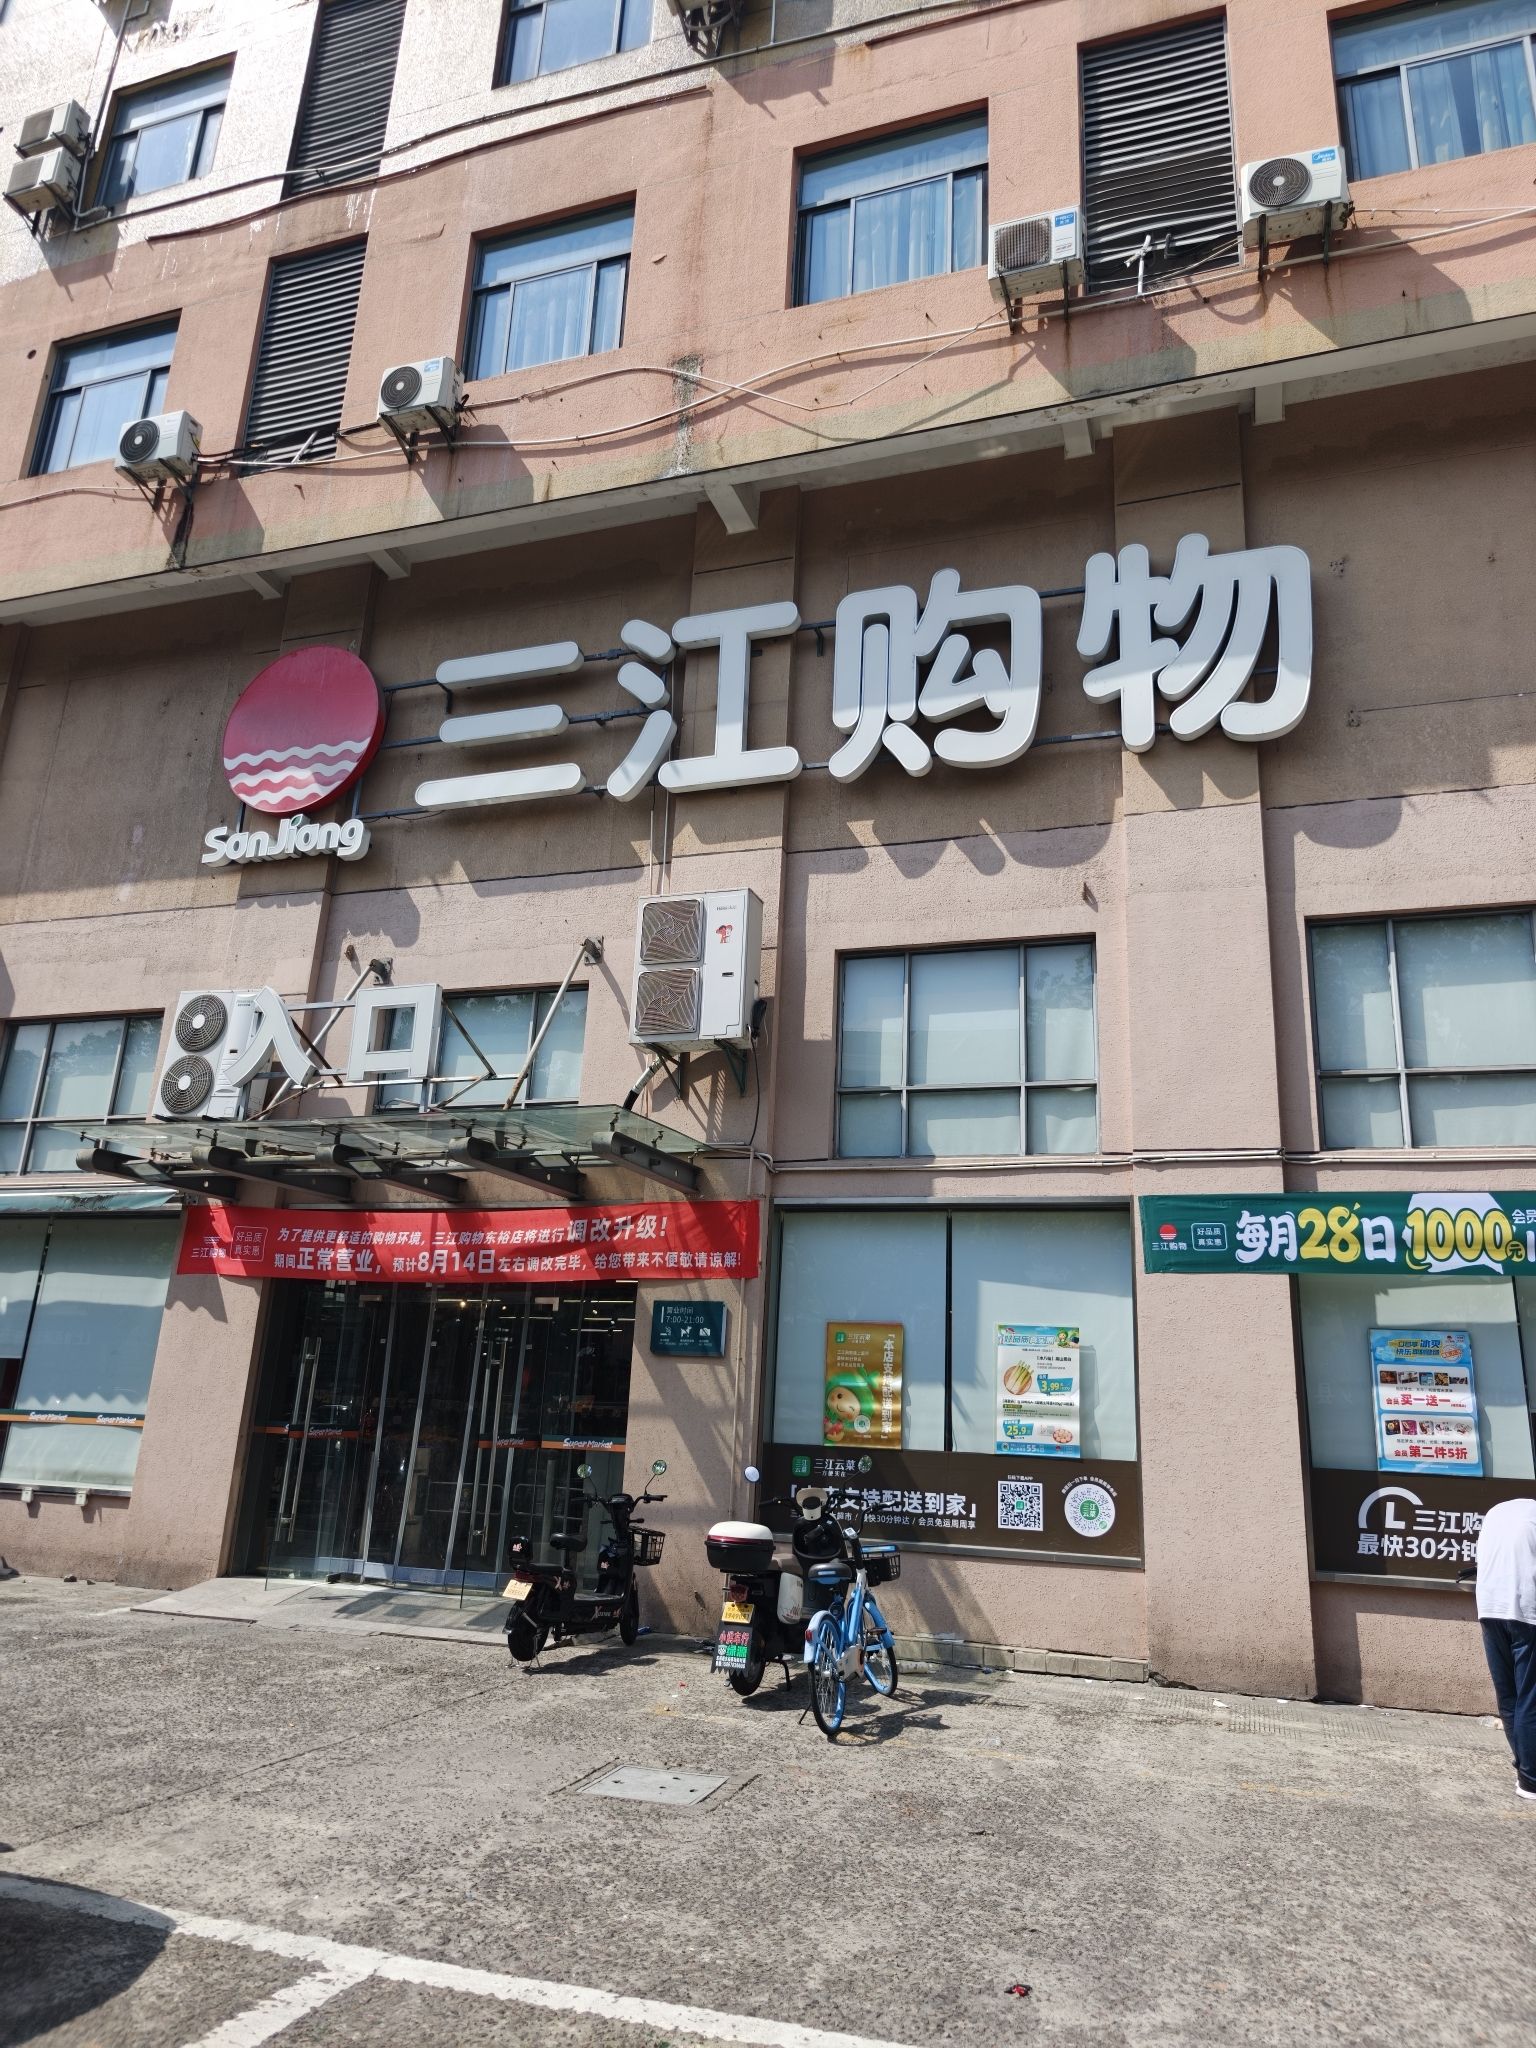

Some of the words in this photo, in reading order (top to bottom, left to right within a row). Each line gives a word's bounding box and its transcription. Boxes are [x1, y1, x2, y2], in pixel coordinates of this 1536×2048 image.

[414, 532, 1314, 808] 三江购物
[201, 813, 370, 868] SanJiang
[222, 984, 443, 1088] 入口
[235, 1230, 263, 1243] 好品质
[1196, 1227, 1221, 1236] 好品质
[1235, 1204, 1396, 1264] 每月28日
[1151, 1241, 1187, 1251] 三江购物
[1197, 1238, 1223, 1247] 真实惠
[190, 1247, 227, 1258] 三江购物
[1400, 1393, 1451, 1407] 买一送一
[1006, 1425, 1027, 1436] 25.9
[562, 1437, 588, 1448] Super
[587, 1439, 613, 1449] Market
[1408, 1445, 1468, 1460] 第二件5折
[813, 1458, 856, 1471] 三江云菜
[790, 1484, 976, 1518] 「支持配送到家」
